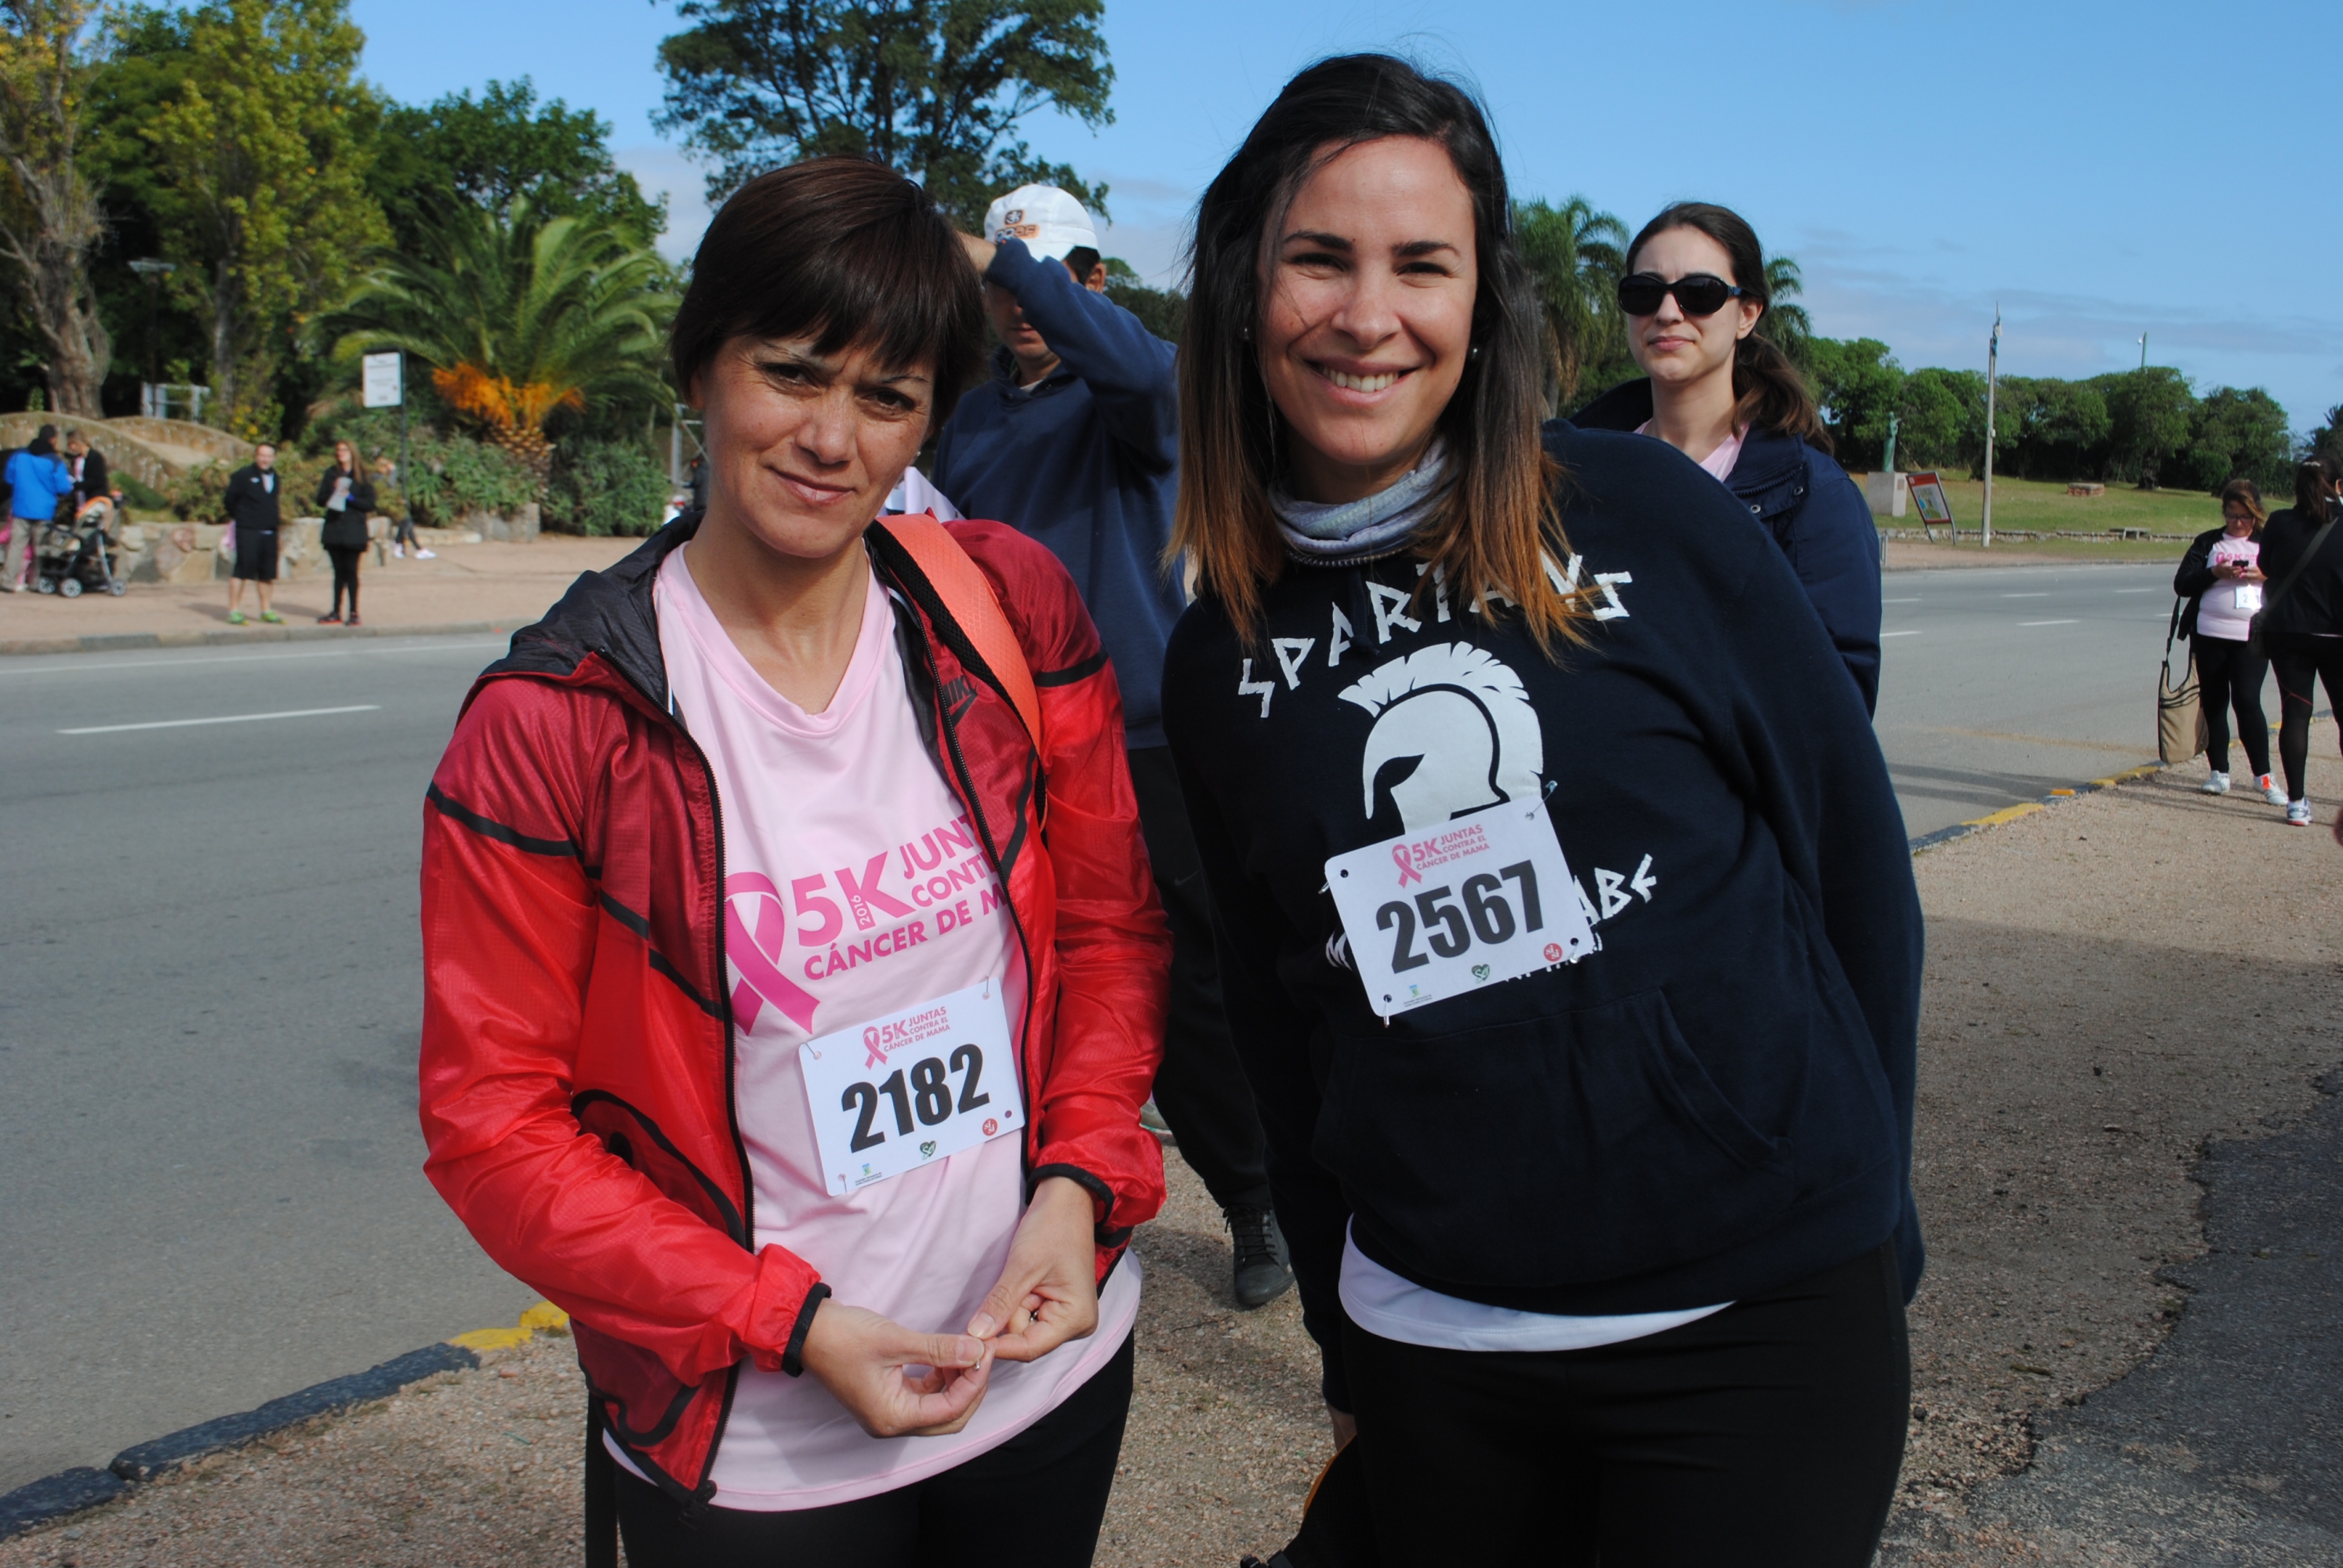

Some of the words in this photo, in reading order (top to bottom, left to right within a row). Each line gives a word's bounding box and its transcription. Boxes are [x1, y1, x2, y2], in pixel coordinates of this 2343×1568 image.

[1441, 824, 1482, 844] JUNTAS
[1443, 838, 1475, 852] CONTRA
[1412, 837, 1443, 862] 5K
[1416, 856, 1448, 869] CÁNCER
[1463, 843, 1490, 856] MAMA
[791, 851, 916, 947] 5K
[851, 895, 870, 925] 2016
[1375, 859, 1544, 975] 2567
[804, 920, 928, 980] CÁNCER
[936, 899, 972, 935] DE
[909, 1007, 946, 1026] JUNTAS
[910, 1020, 939, 1034] CONTRA
[882, 1019, 910, 1044] 5K
[884, 1037, 913, 1051] CÁNCER
[915, 1031, 924, 1041] DE
[926, 1024, 950, 1037] MAMA
[841, 1044, 990, 1154] 2182
